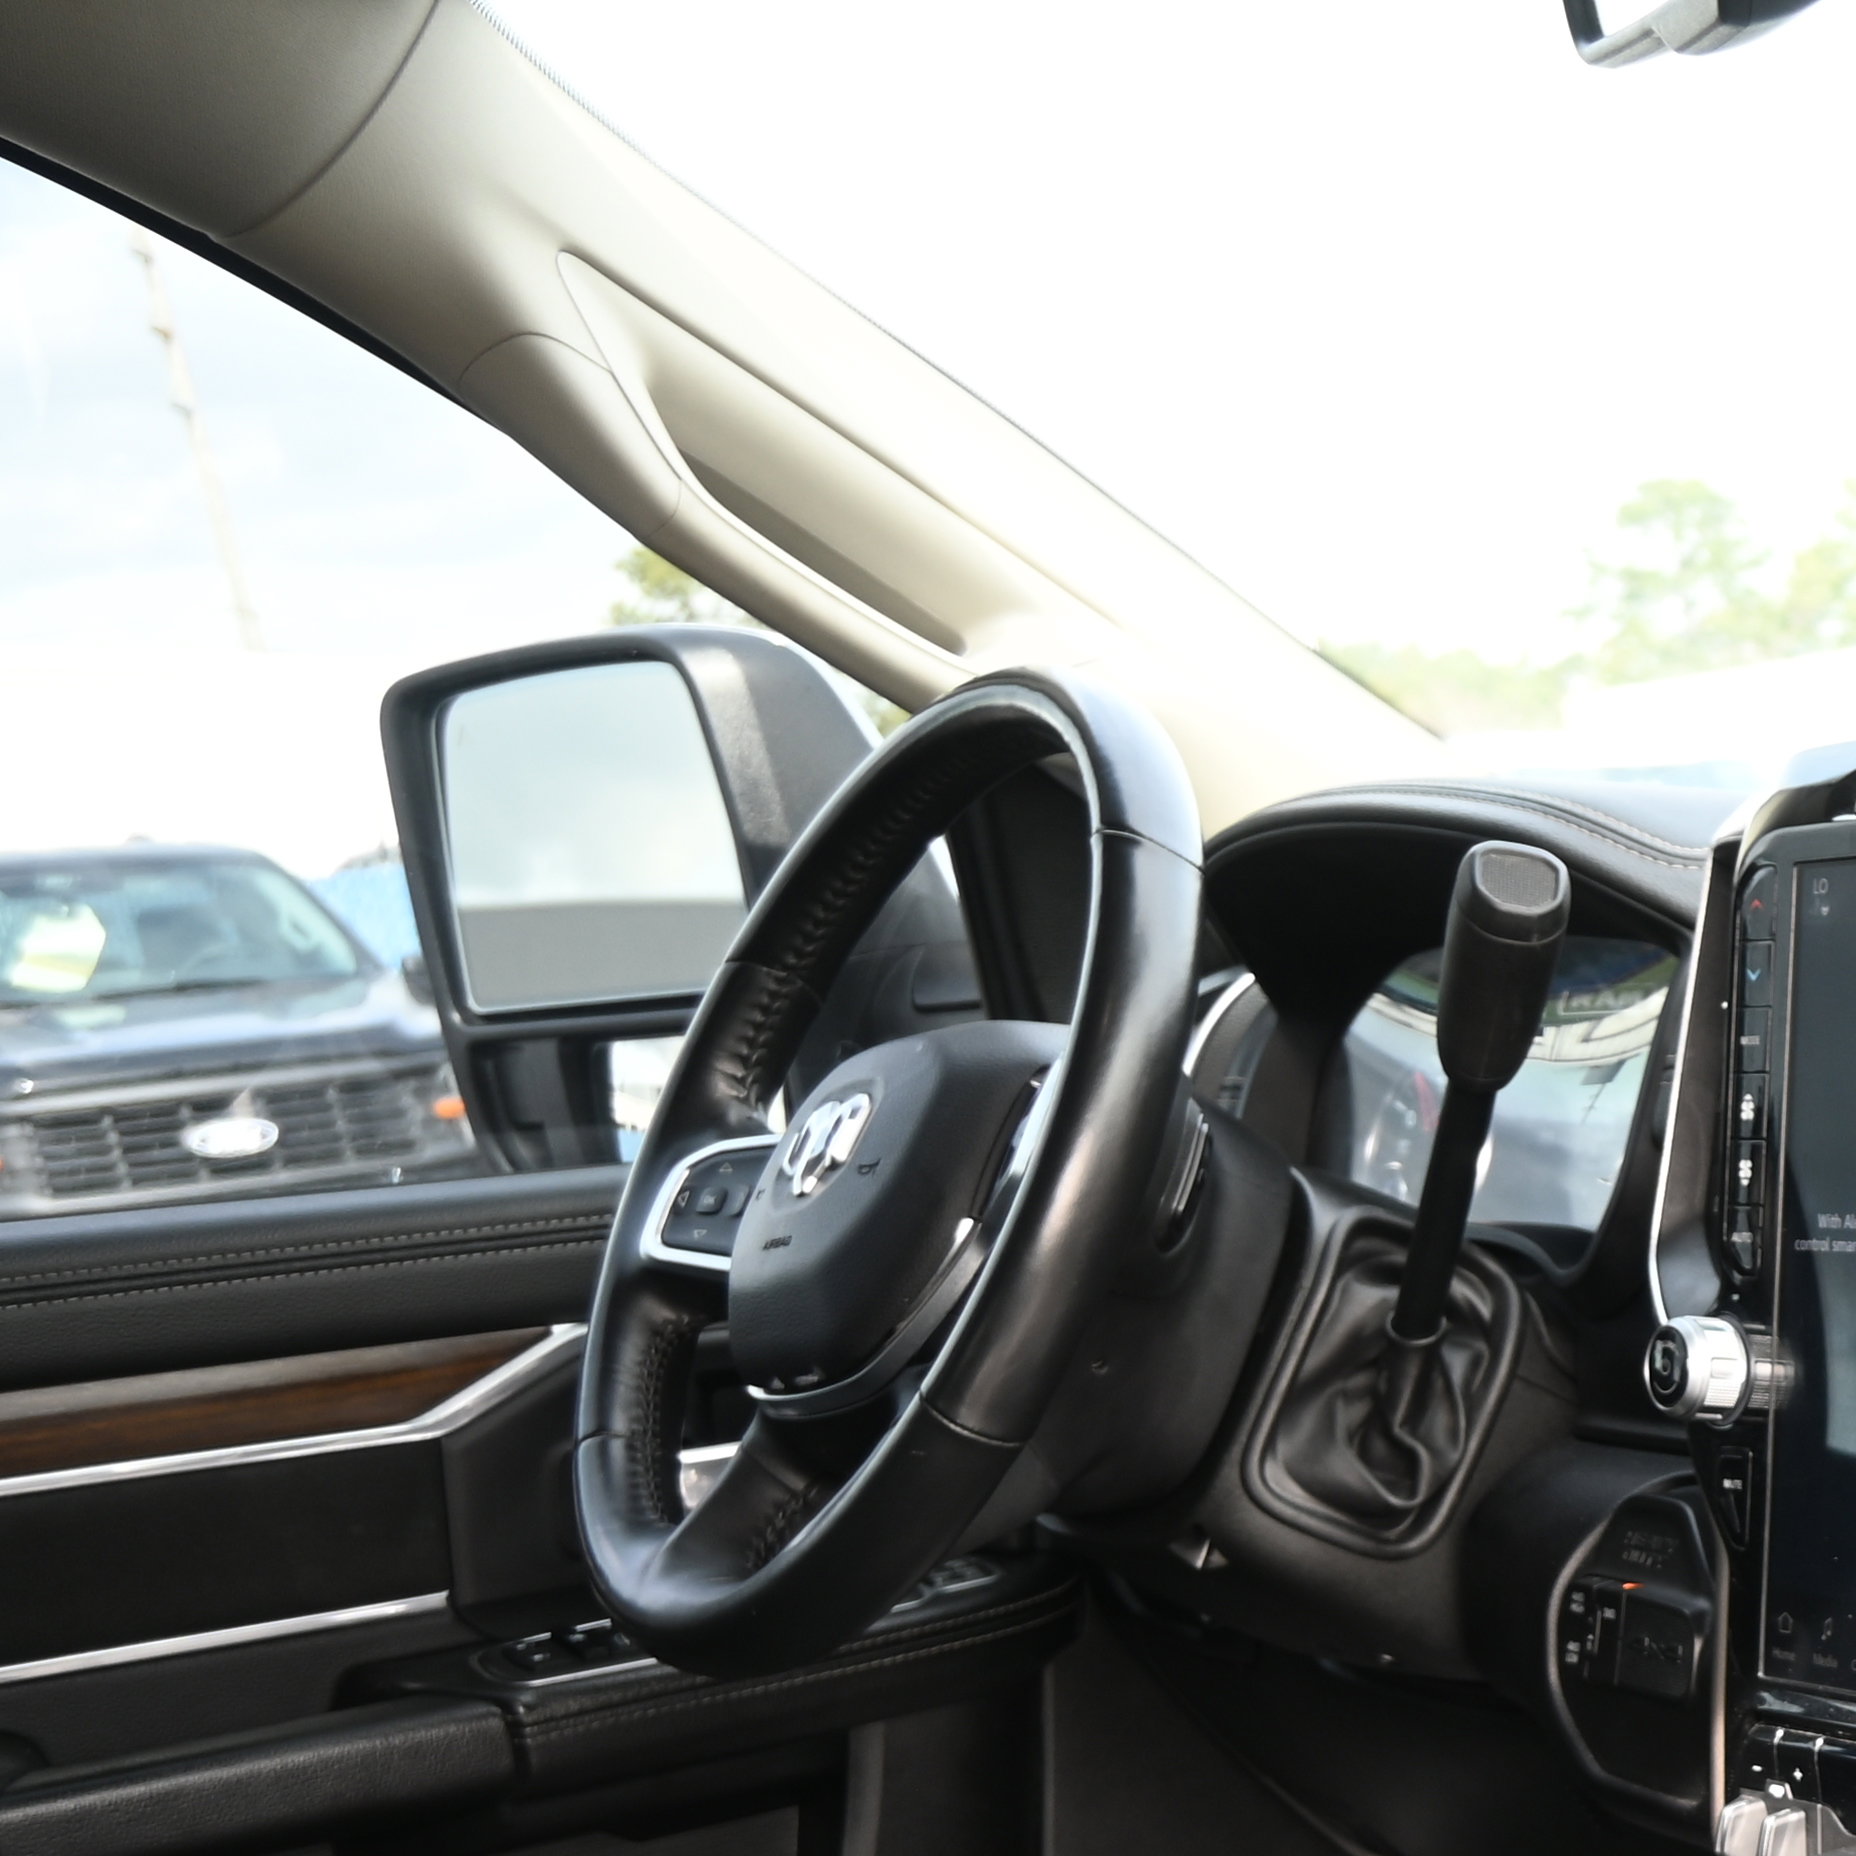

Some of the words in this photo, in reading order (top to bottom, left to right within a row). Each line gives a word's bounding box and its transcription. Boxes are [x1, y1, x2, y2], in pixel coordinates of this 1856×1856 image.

[1812, 876, 1829, 894] LO
[1817, 1213, 1842, 1229] With
[1794, 1237, 1829, 1253] control
